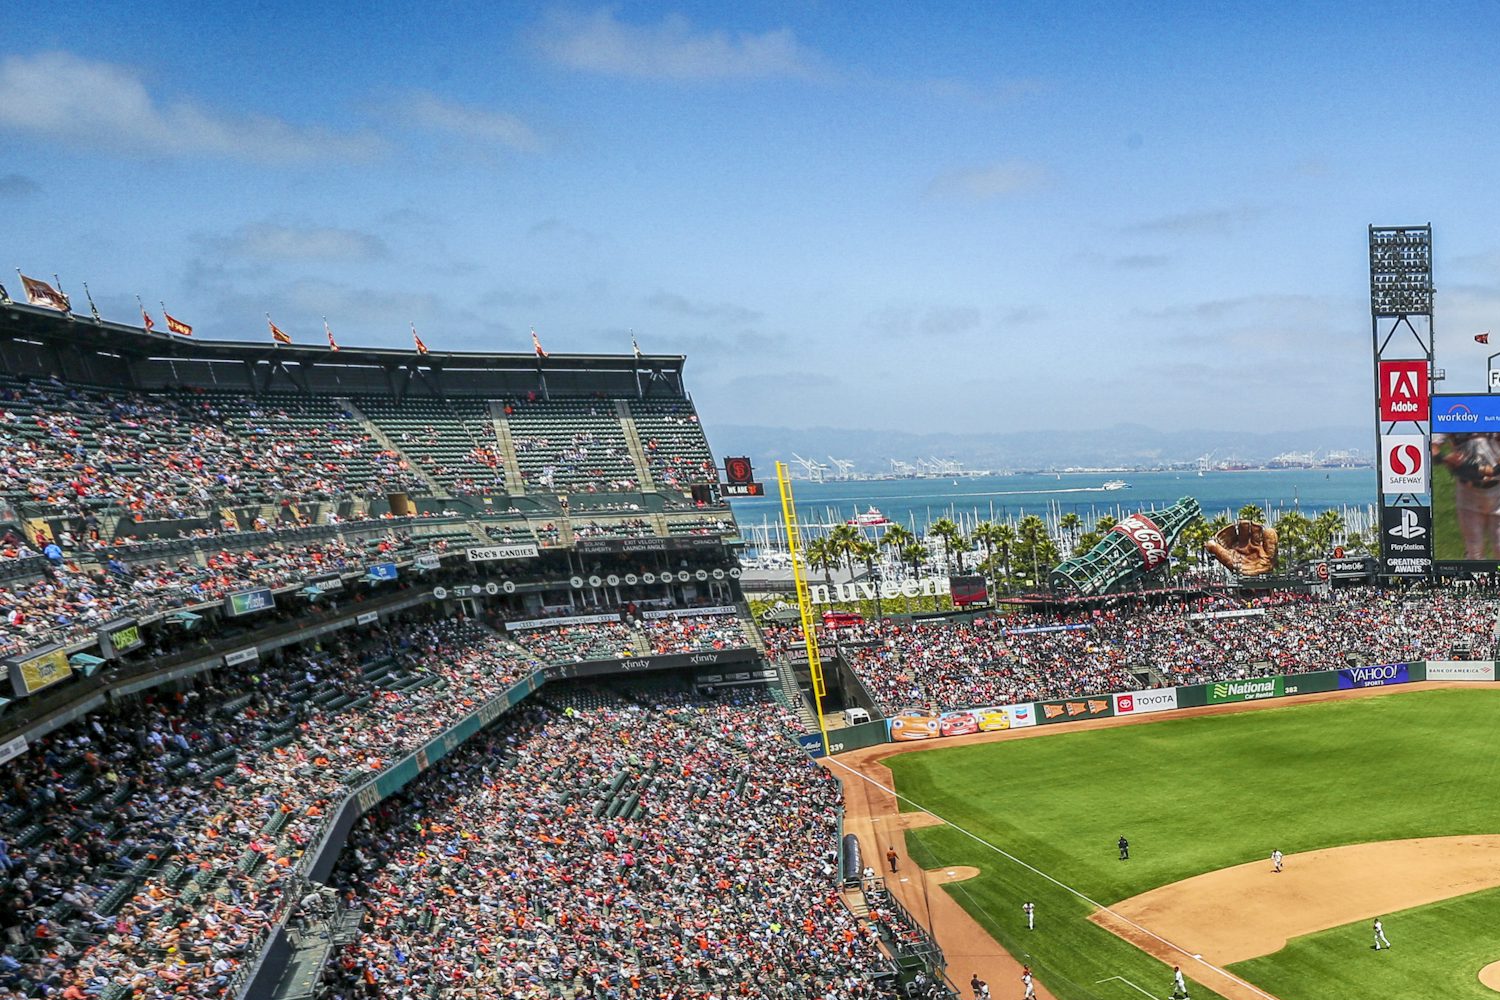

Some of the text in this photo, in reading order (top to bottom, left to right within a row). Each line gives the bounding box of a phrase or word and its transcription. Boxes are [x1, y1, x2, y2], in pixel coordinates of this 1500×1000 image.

[1391, 401, 1418, 413] Adobe
[1437, 412, 1479, 424] workday
[727, 486, 737, 494] WE
[737, 486, 749, 494] ARE
[1390, 543, 1425, 552] PlayStation
[470, 548, 534, 559] See's CANDIES
[1387, 557, 1431, 566] GREATNESS
[810, 577, 945, 604] nuveen
[690, 652, 718, 664] xfinity
[621, 658, 650, 670] xfinity
[1350, 664, 1398, 683] YAHOO!
[1228, 679, 1276, 696] National
[1364, 680, 1384, 688] SPORTS
[1255, 691, 1274, 699] Rental
[1284, 686, 1298, 694] 382
[1136, 694, 1174, 706] TOYOTA
[829, 743, 844, 753] 339
